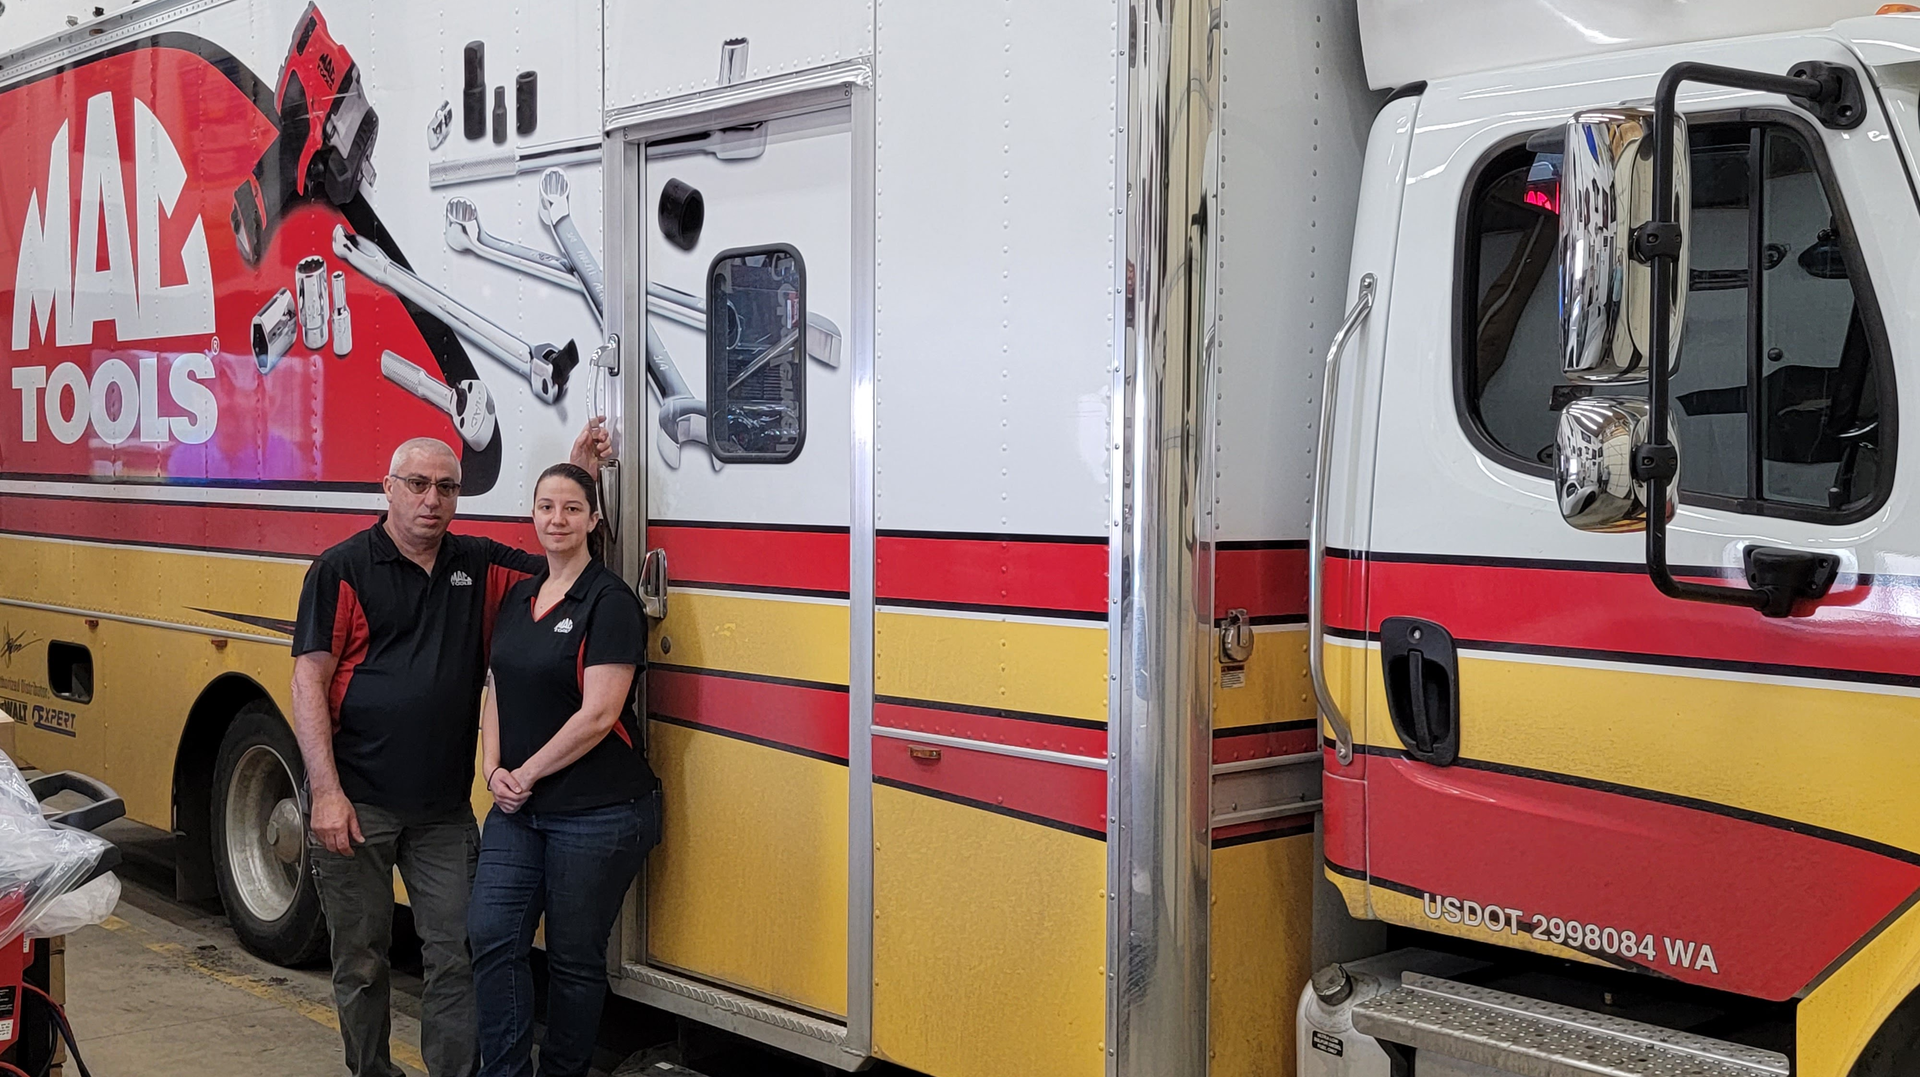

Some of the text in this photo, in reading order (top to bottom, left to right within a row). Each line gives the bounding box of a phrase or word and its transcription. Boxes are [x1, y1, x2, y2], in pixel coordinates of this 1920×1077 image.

[12, 91, 216, 351] MAC
[12, 353, 218, 444] TOOLS
[450, 570, 473, 581] MAC
[1422, 892, 1720, 974] USDOT 2998084 WA
